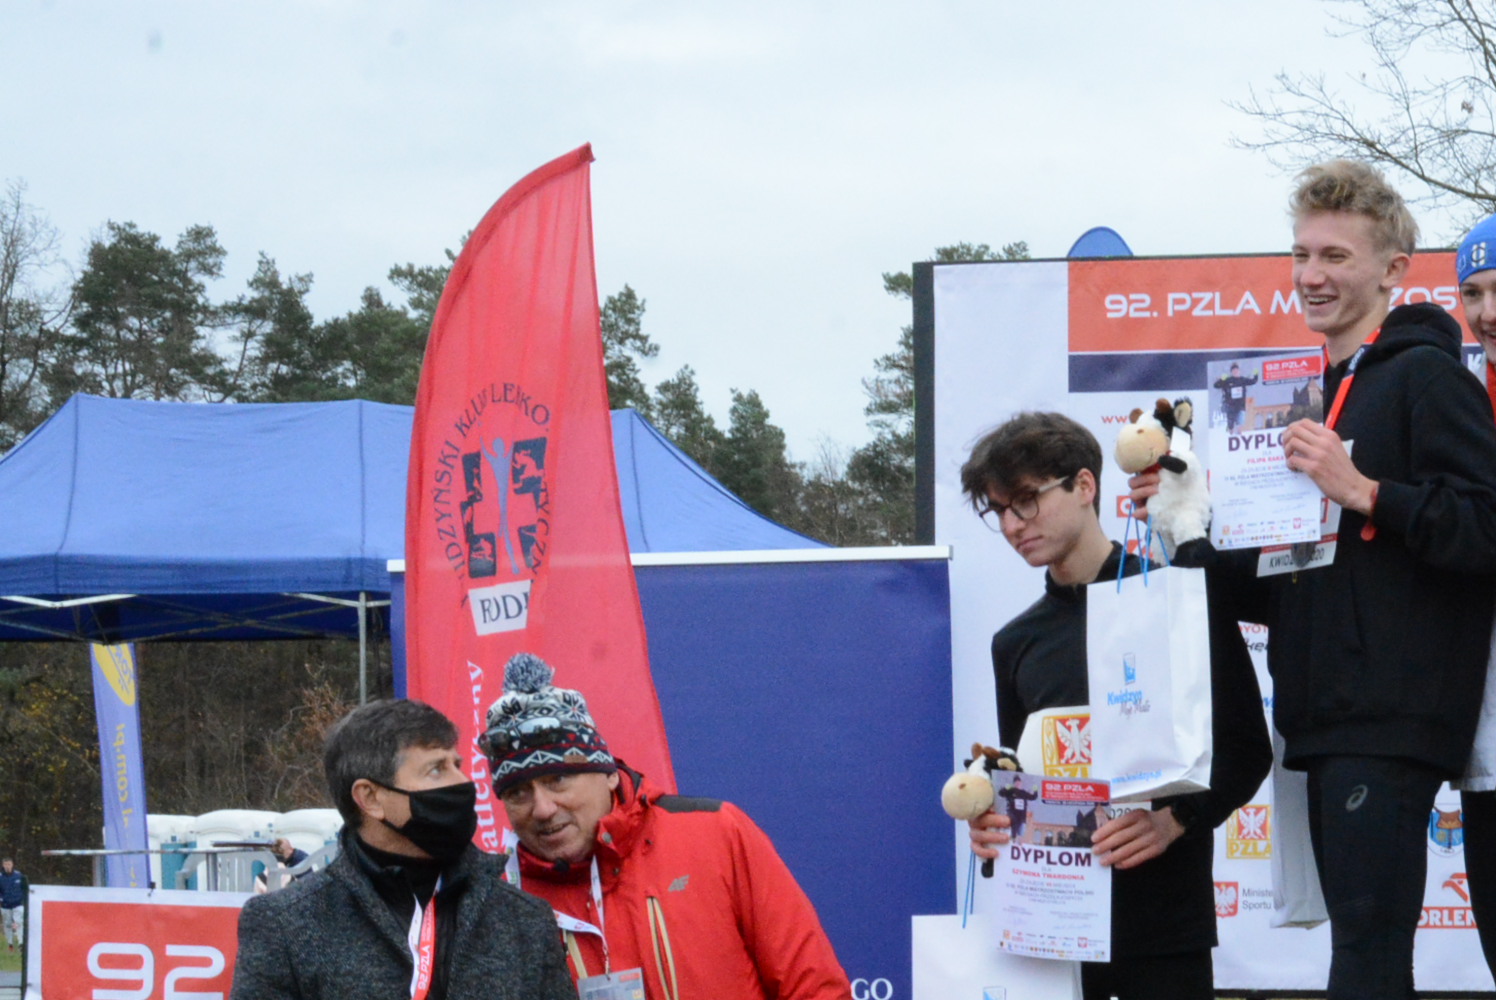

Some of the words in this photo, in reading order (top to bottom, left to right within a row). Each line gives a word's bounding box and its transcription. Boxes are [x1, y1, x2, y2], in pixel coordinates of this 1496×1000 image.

[1104, 293, 1158, 318] 92.
[1167, 290, 1262, 317] PZLA
[1228, 432, 1284, 452] DYPL
[1010, 845, 1093, 867] DYPLOM
[1230, 840, 1272, 855] PZLA
[1242, 887, 1274, 898] Ministe
[1242, 900, 1272, 911] Sportu
[419, 945, 431, 974] PZLA
